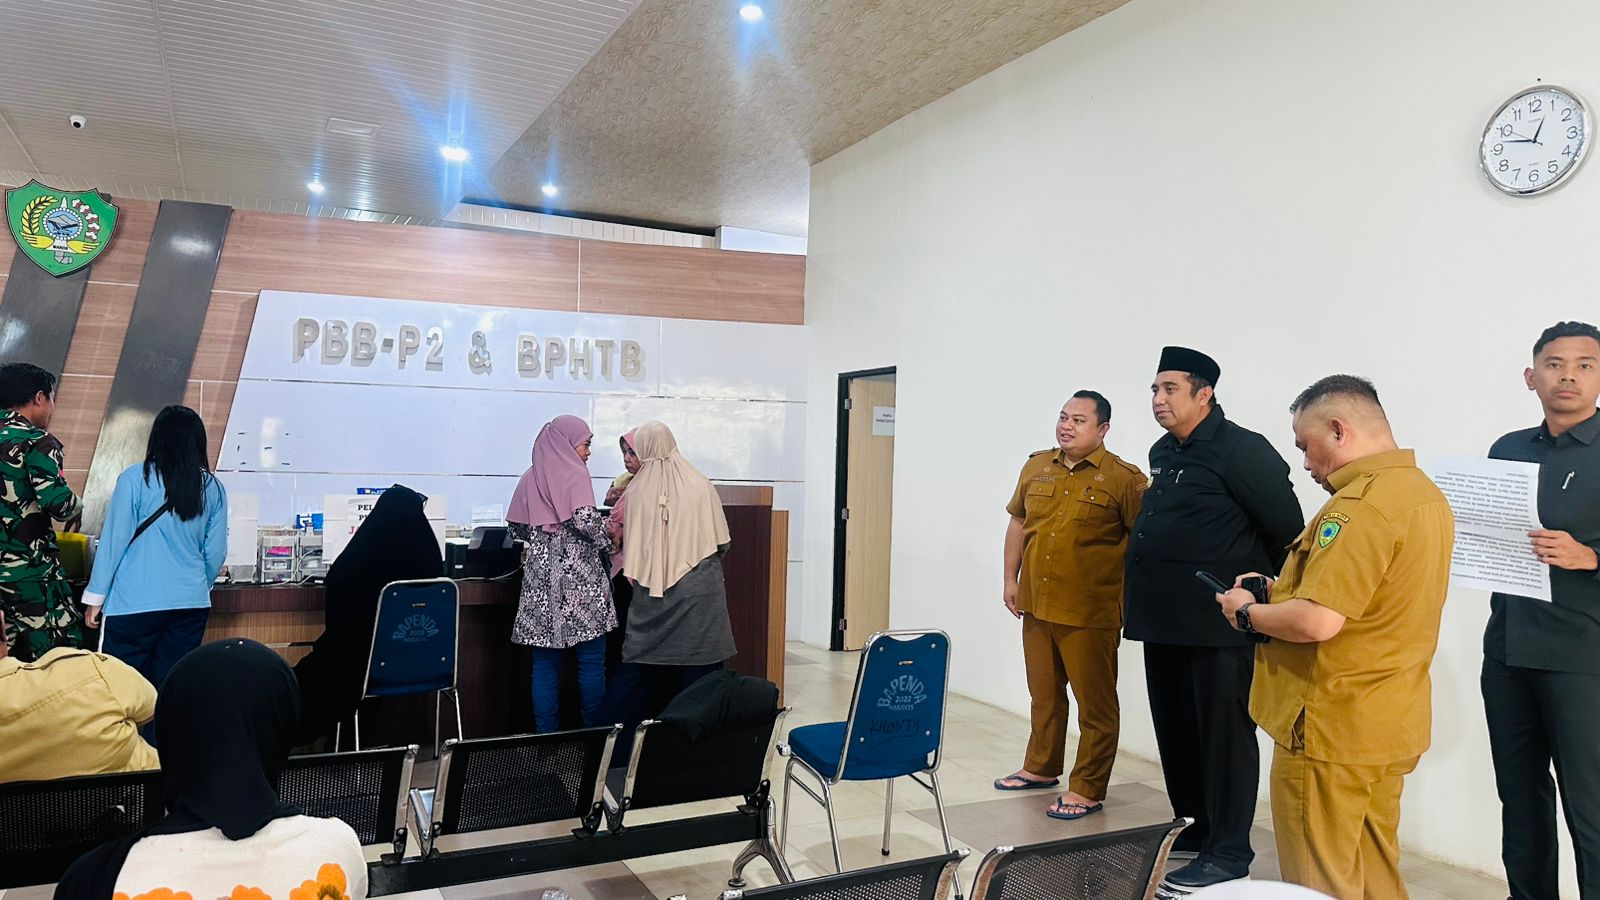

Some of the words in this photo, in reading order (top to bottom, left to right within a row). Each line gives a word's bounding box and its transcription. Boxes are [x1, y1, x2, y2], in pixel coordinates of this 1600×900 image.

[1528, 99, 1542, 113] 12
[1550, 99, 1555, 111] 1
[1513, 108, 1522, 122] 11
[1561, 107, 1572, 122] 2
[1496, 123, 1513, 138] 10
[1566, 125, 1578, 139] 3
[1493, 143, 1504, 156] 9
[1561, 144, 1571, 157] 4
[1498, 159, 1509, 172] 8
[1547, 160, 1559, 173] 5
[1512, 167, 1521, 181] 7
[1528, 169, 1539, 182] 6
[294, 318, 445, 371] PBB-P2
[468, 331, 492, 374] &
[517, 335, 645, 381] BPHTB
[392, 614, 439, 639] BAPENDA
[877, 675, 927, 707] BAPENDA
[895, 695, 911, 703] 2022
